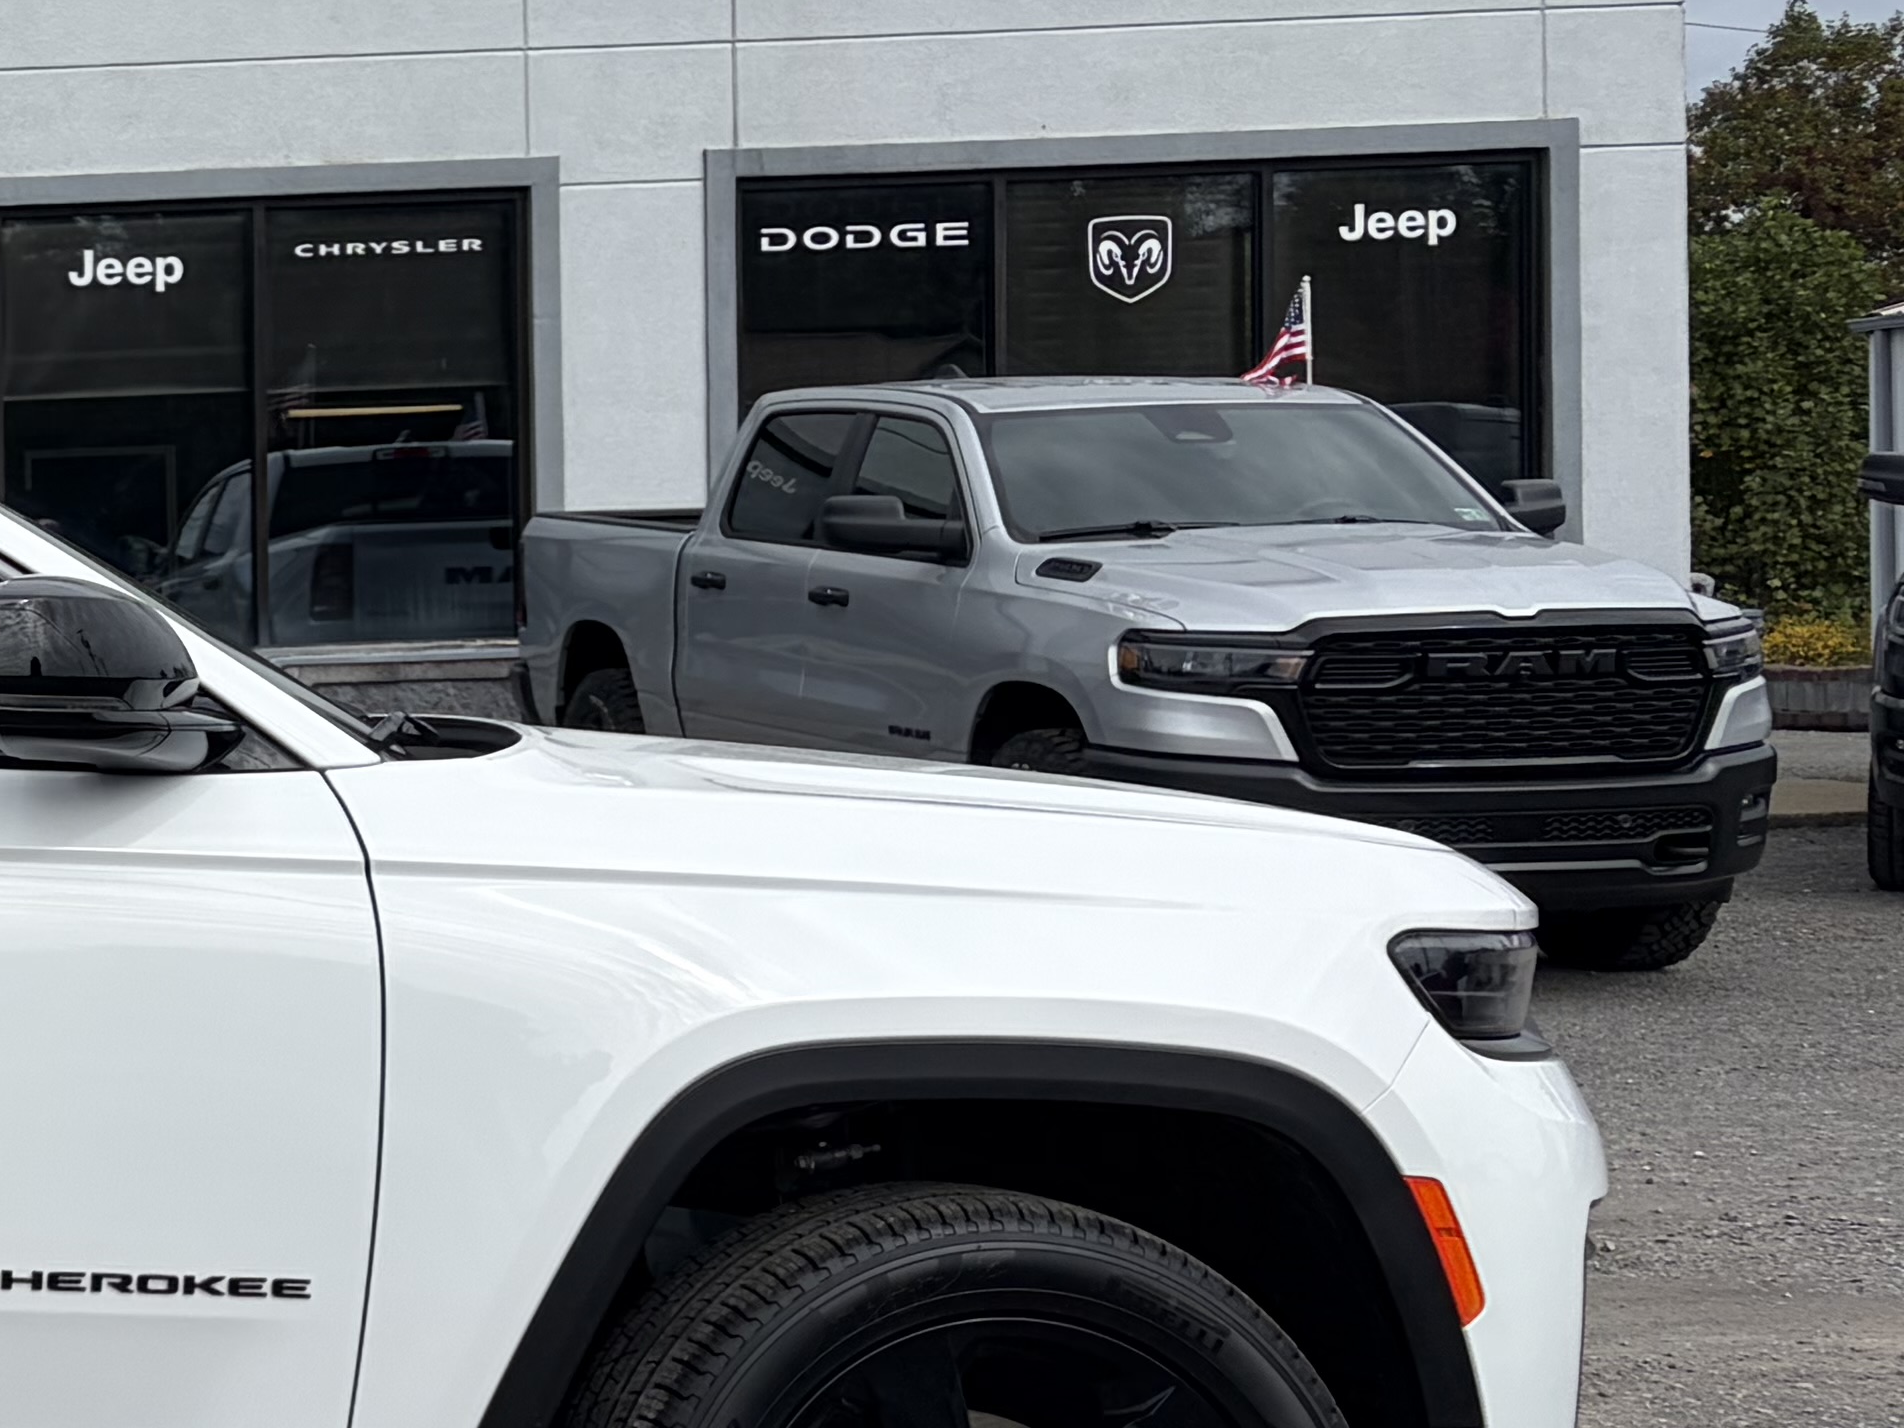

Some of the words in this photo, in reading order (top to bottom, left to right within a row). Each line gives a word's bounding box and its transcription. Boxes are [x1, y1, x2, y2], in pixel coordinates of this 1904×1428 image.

[759, 220, 971, 253] DODGE
[1338, 202, 1457, 246] Jeep
[294, 237, 484, 259] CHRYSLER
[68, 248, 184, 293] Jeep
[1427, 648, 1617, 677] RAM
